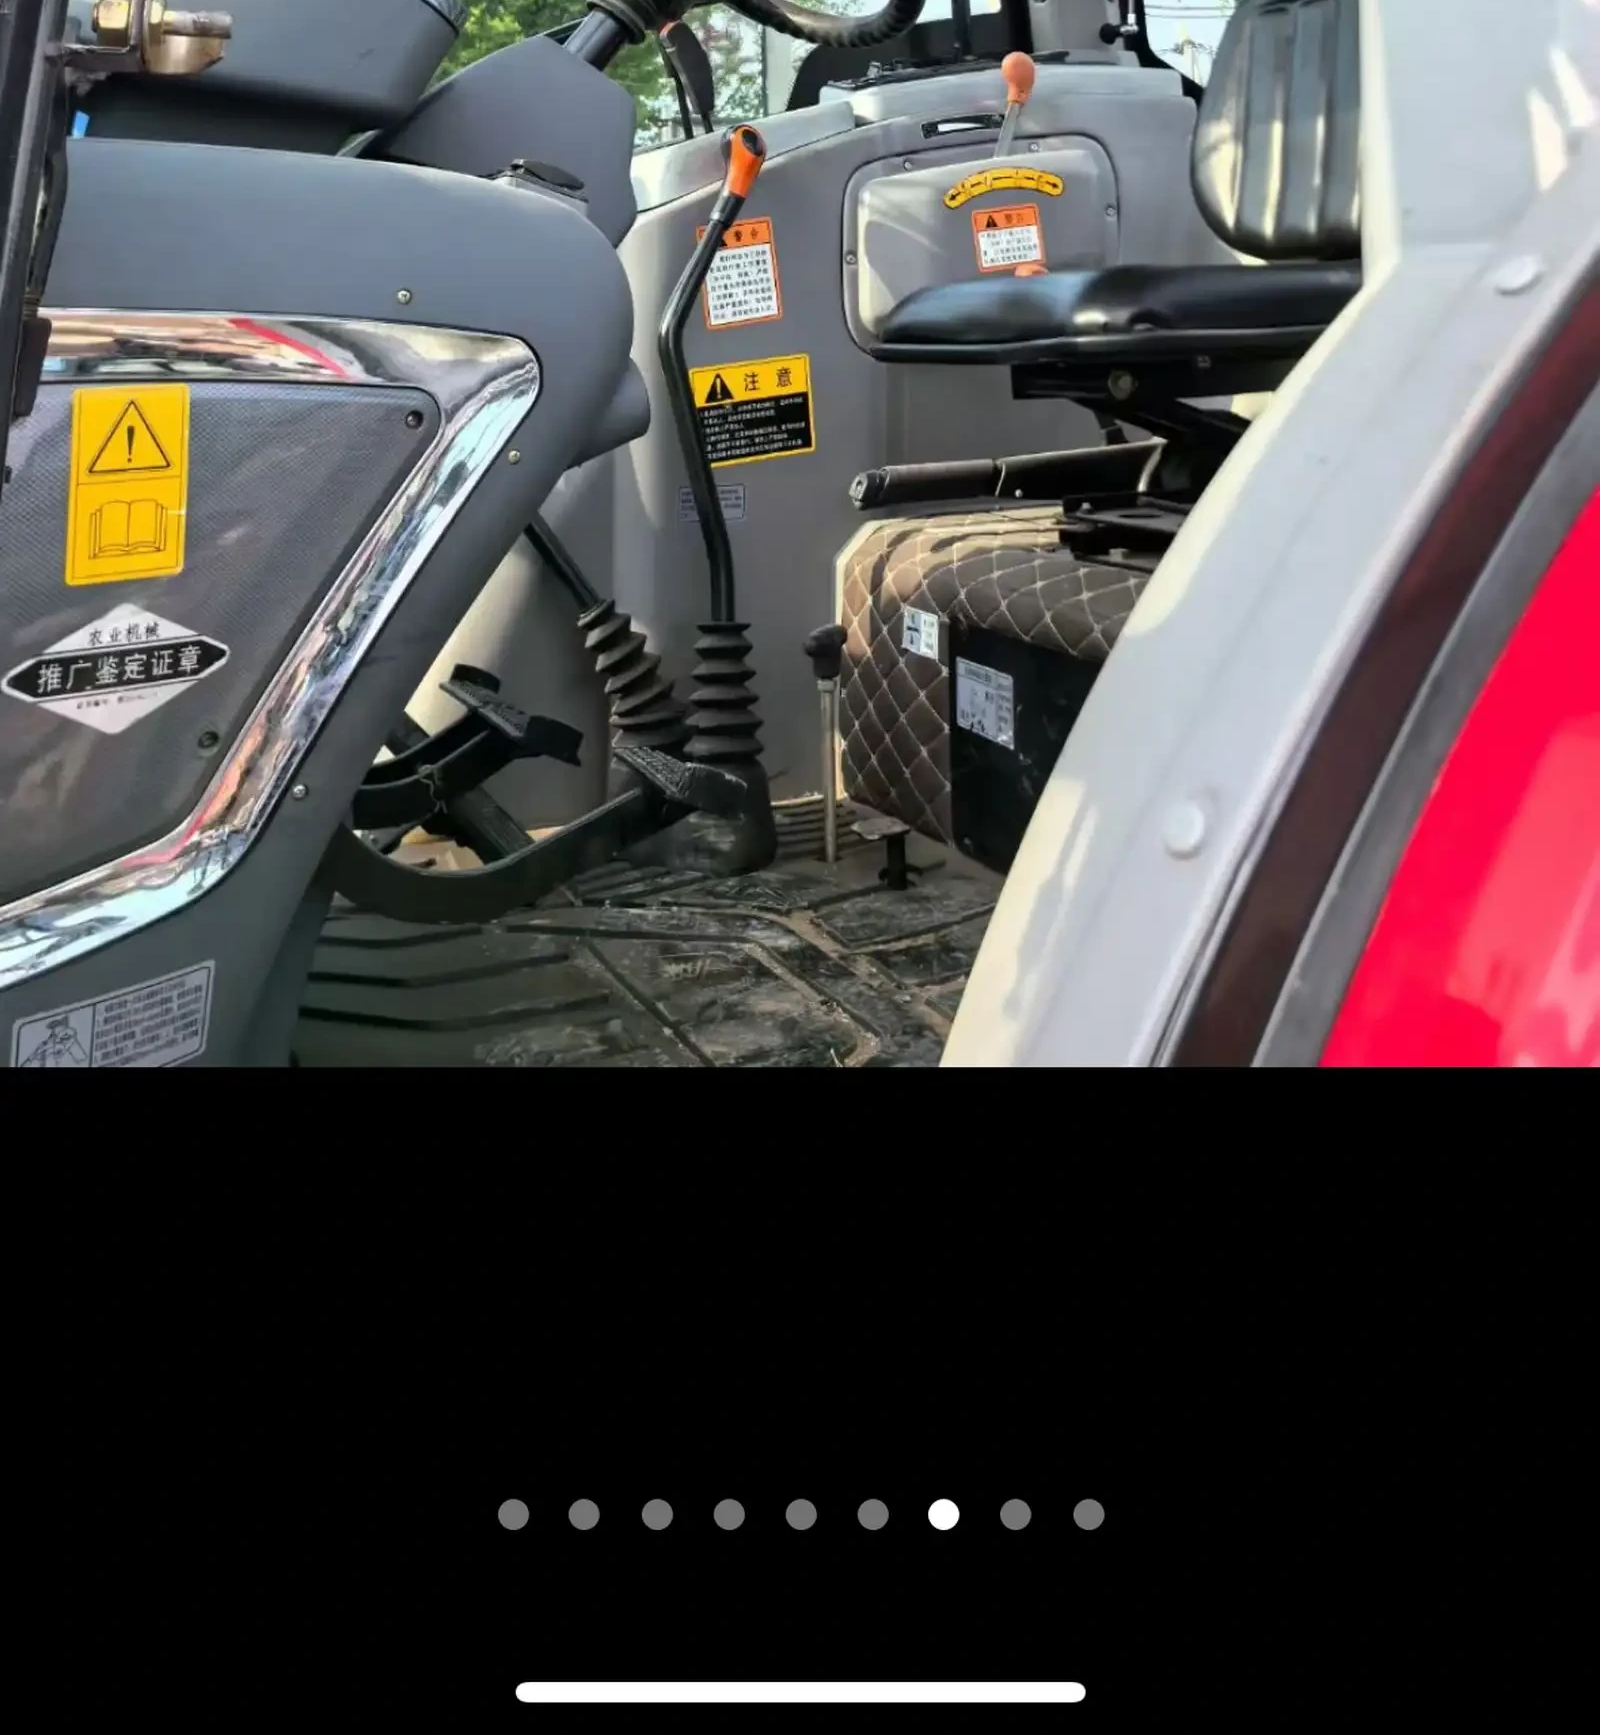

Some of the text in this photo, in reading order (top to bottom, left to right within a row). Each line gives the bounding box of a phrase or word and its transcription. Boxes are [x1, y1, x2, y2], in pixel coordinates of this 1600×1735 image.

[744, 366, 793, 392] 注意
[88, 622, 161, 645] 农业机械
[37, 645, 201, 694] 推广鉴定证章
